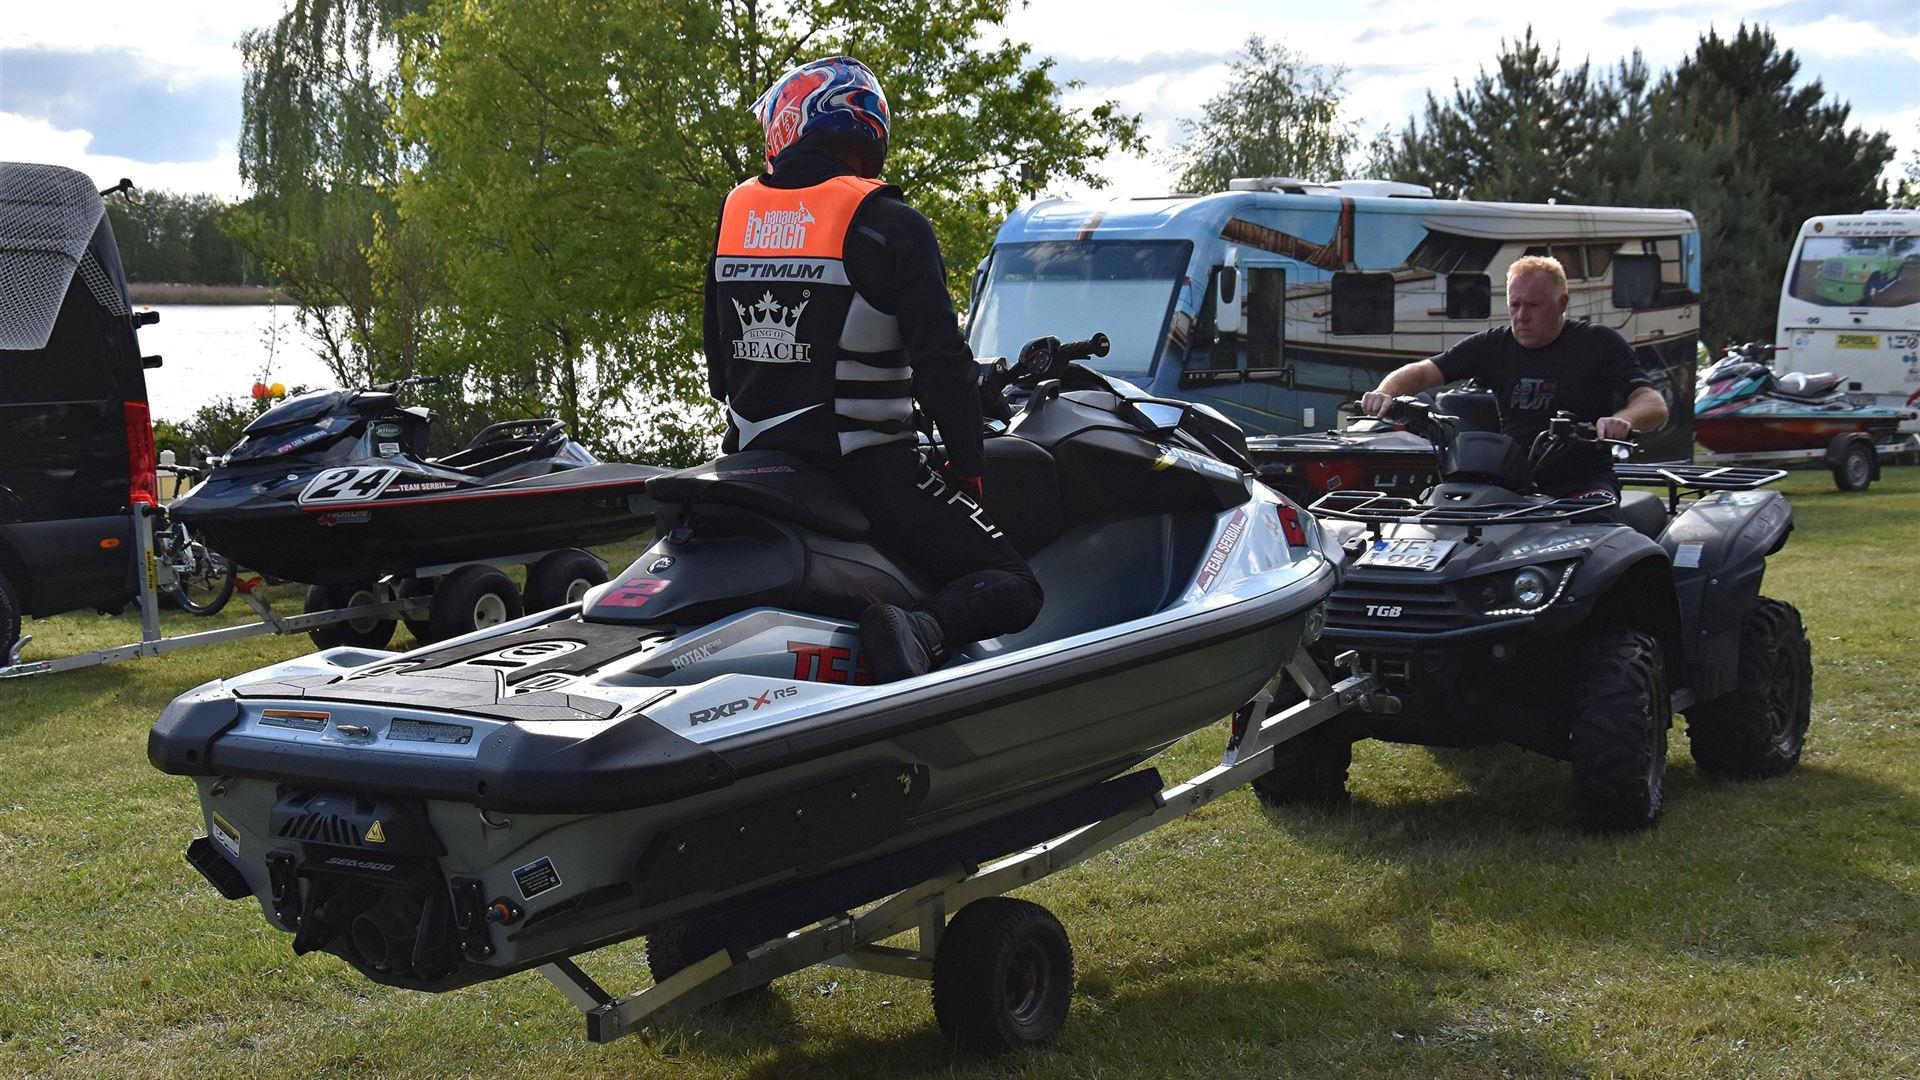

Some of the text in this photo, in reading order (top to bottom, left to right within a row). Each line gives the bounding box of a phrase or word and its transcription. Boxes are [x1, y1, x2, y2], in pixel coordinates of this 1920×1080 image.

[743, 209, 806, 249] beach
[721, 263, 825, 280] OPTIMUM
[750, 330, 787, 339] KING OF
[733, 341, 811, 362] BEACH
[307, 468, 392, 500] 24
[399, 481, 447, 492] TEAM SERBIA
[1204, 522, 1243, 577] TEAM SERBIA
[1389, 540, 1427, 554] TF
[1366, 604, 1403, 618] TGB
[671, 645, 713, 672] ROTAX
[773, 685, 799, 700] RS
